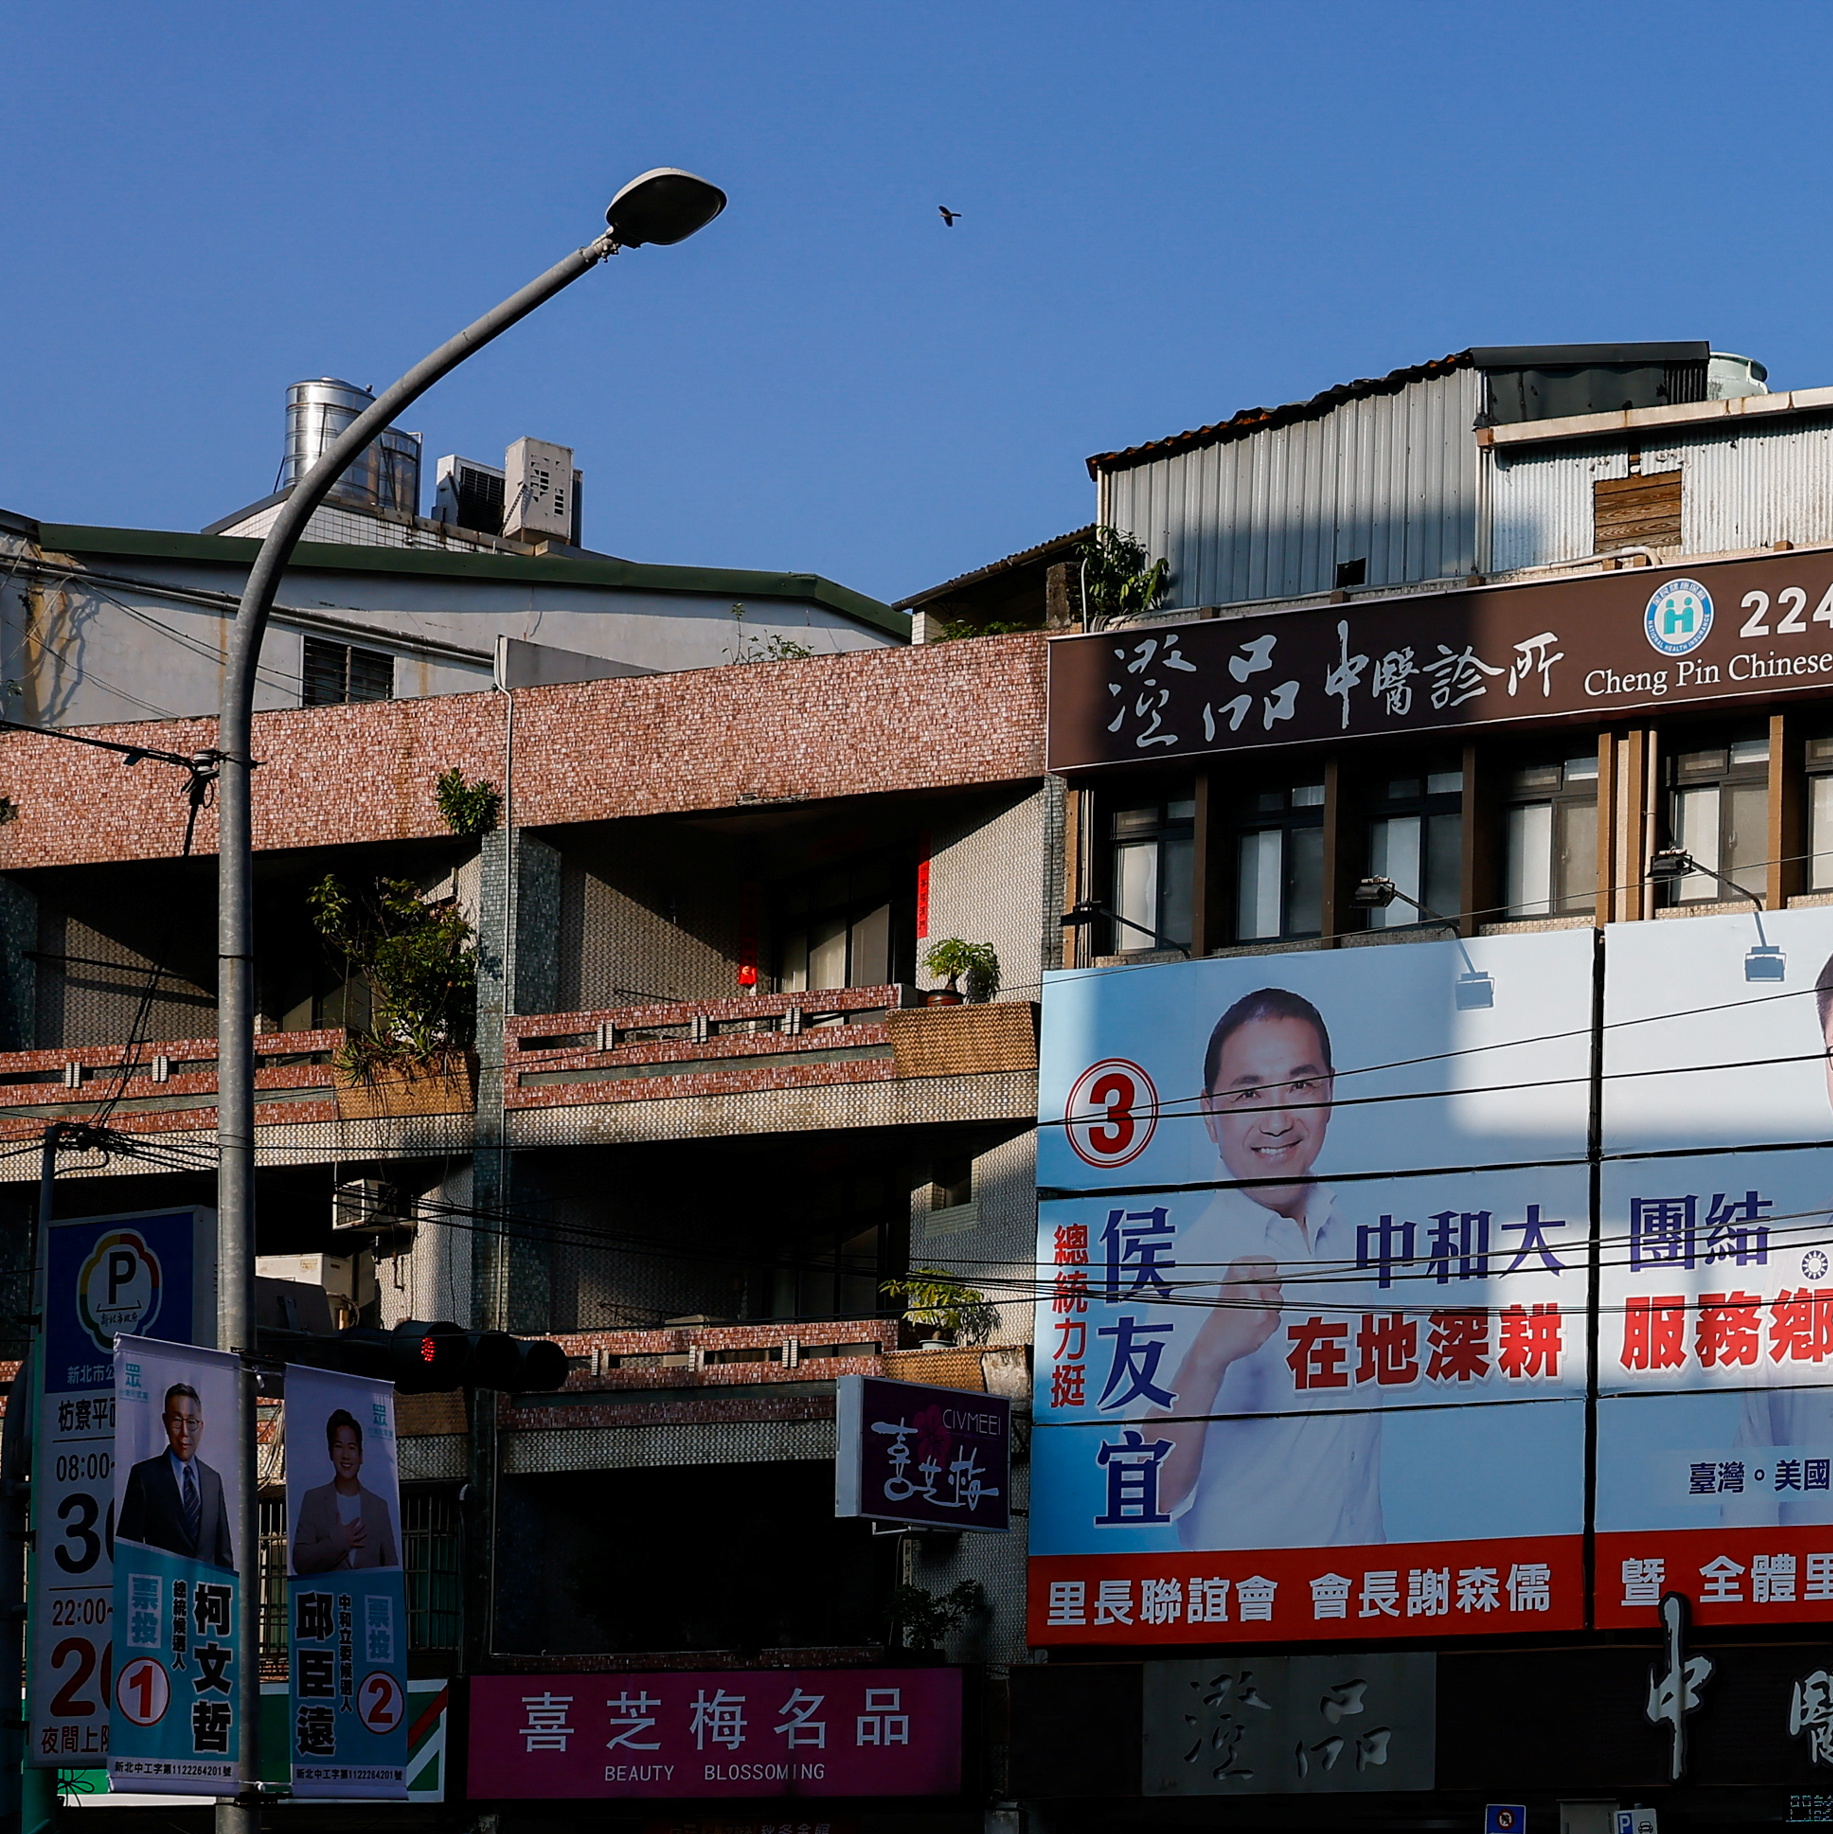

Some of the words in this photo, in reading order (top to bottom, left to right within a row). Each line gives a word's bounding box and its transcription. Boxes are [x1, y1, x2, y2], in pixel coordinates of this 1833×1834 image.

[1585, 660, 1667, 697] Cheng
[1676, 657, 1720, 687] Pin
[1728, 650, 1832, 680] Chinese
[1089, 1072, 1137, 1155] 3
[109, 1251, 136, 1304] P
[1355, 1203, 1568, 1290] 中和大
[1628, 1191, 1772, 1275] 團結
[1050, 1225, 1089, 1408] 總統力挺
[1285, 1302, 1565, 1392] 在地深耕
[1094, 1206, 1179, 1528] 侯友宜
[55, 1494, 116, 1574] 3
[1047, 1577, 1278, 1627] 里長聯誼會
[1310, 1563, 1552, 1620] 會長謝森儒
[1619, 1559, 1666, 1607] 暨
[50, 1637, 113, 1717] 2
[129, 1664, 153, 1719] 1
[190, 1581, 232, 1754] 柯文哲
[295, 1590, 336, 1758] 邱臣遠
[367, 1677, 393, 1724] 2
[518, 1687, 911, 1753] 喜芝梅名品
[604, 1765, 675, 1782] BEAUTY
[704, 1764, 826, 1782] BLOSSOMING
